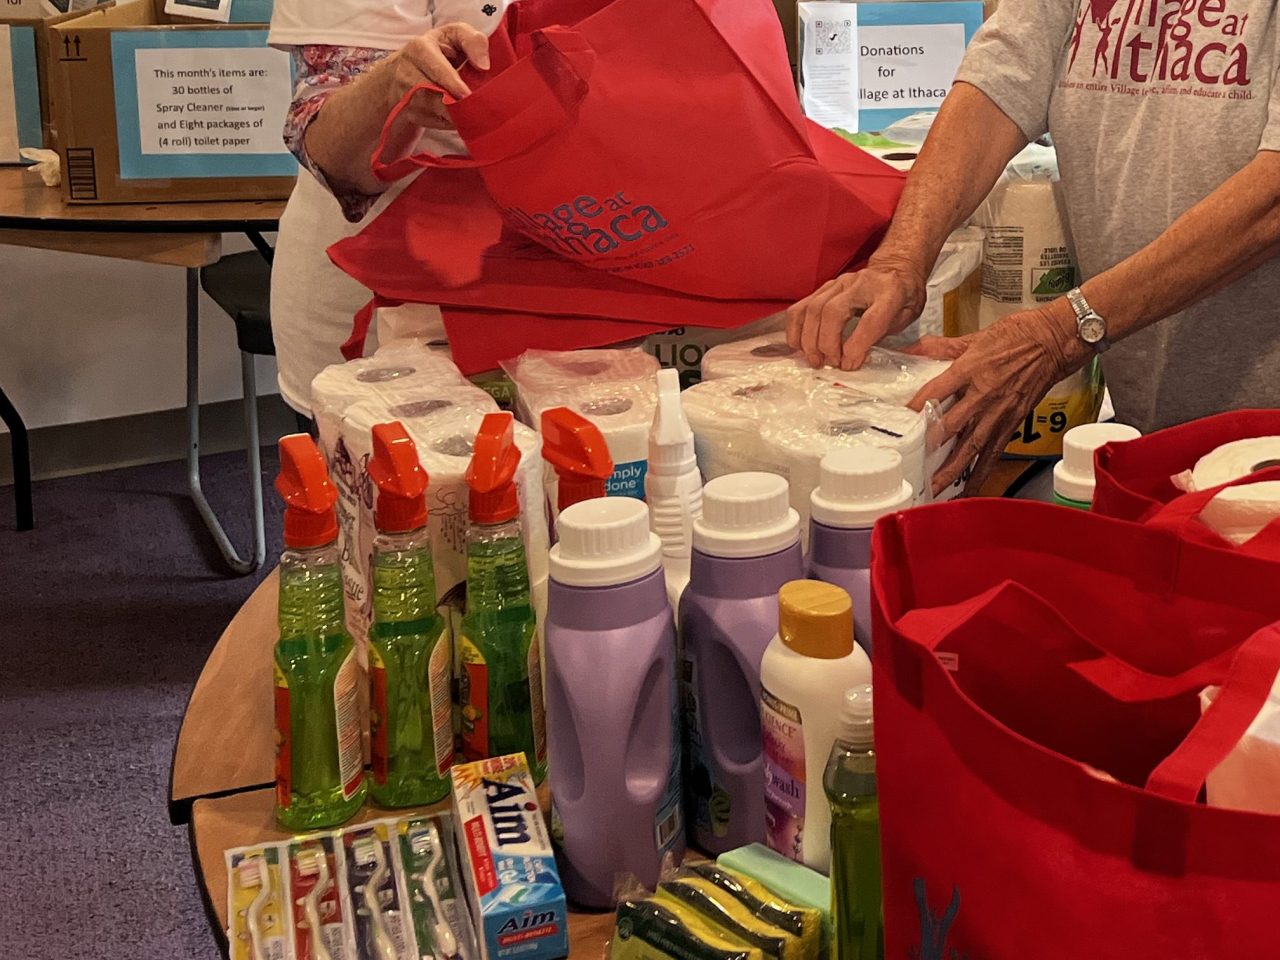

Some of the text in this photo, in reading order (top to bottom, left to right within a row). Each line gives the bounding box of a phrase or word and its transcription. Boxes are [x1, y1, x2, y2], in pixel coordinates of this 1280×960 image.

[1221, 13, 1249, 37] at
[859, 43, 925, 57] Donations
[1110, 33, 1251, 86] Ithaca
[153, 68, 268, 78] This month's items are:
[877, 65, 896, 78] for
[172, 84, 233, 95] 30 bottles of
[858, 86, 947, 102] llage at Ithaca
[1110, 83, 1140, 96] Village
[156, 103, 185, 114] Spray
[186, 102, 224, 112] Cleaner
[157, 118, 264, 131] and Eight packages of
[158, 136, 251, 148] (4 roll) toilet paper
[604, 190, 633, 212] at
[605, 480, 637, 492] done
[772, 776, 800, 800] wash
[480, 776, 538, 847] Aim
[496, 908, 556, 934] Aim
